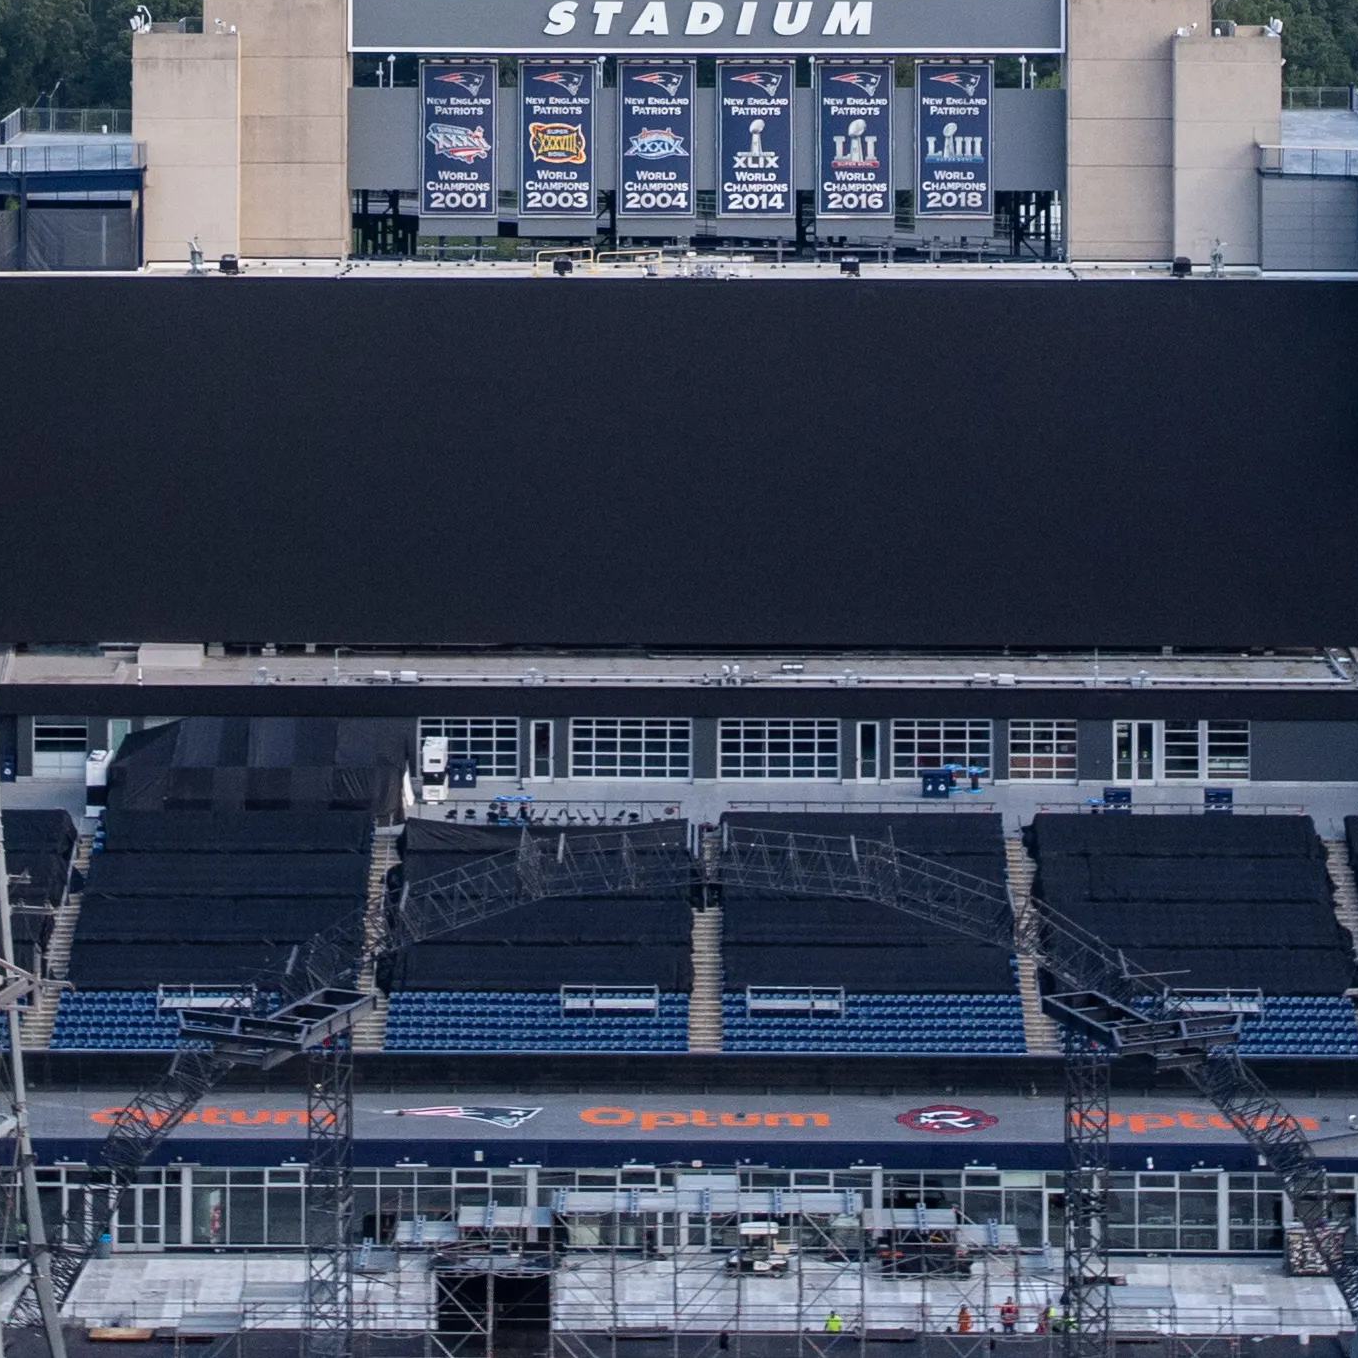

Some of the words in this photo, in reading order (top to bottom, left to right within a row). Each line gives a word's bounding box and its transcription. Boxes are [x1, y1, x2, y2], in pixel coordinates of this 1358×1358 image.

[543, 1, 873, 35] STADIUM
[426, 97, 448, 105] NEW
[450, 97, 491, 105] ENGLAND
[526, 96, 546, 104] NEW
[548, 96, 590, 105] ENGLAND
[624, 97, 646, 105] NEW
[648, 97, 689, 105] ENGLAND
[724, 98, 744, 106] NEW
[746, 98, 788, 106] ENGLAND
[824, 98, 844, 106] NEW
[846, 98, 888, 106] ENGLAND
[922, 97, 944, 105] NEW
[946, 97, 987, 105] ENGLAND
[434, 106, 484, 115] PATRIOTS
[534, 105, 583, 115] PATRIOTS
[632, 106, 682, 115] PATRIOTS
[732, 106, 781, 116] PATRIOTS
[832, 106, 881, 116] PATRIOTS
[930, 106, 980, 115] PATRIOTS
[629, 139, 685, 154] XXXIX
[732, 155, 780, 169] XLIX
[438, 170, 479, 181] WORLD
[536, 170, 578, 180] WORLD
[636, 170, 677, 181] WORLD
[734, 171, 776, 181] WORLD
[834, 171, 876, 181] WORLD
[934, 170, 975, 181] WORLD
[426, 181, 490, 192] CHAMPIONS
[525, 180, 589, 191] CHAMPIONS
[624, 181, 688, 192] CHAMPIONS
[723, 182, 787, 192] CHAMPIONS
[823, 182, 887, 192] CHAMPIONS
[922, 181, 986, 192] CHAMPIONS
[430, 193, 486, 208] 2001
[526, 192, 588, 208] 2003
[625, 193, 688, 208] 2004
[727, 194, 784, 209] 2014
[827, 194, 883, 209] 2016
[926, 193, 982, 208] 2018
[579, 1107, 830, 1131] Optum
